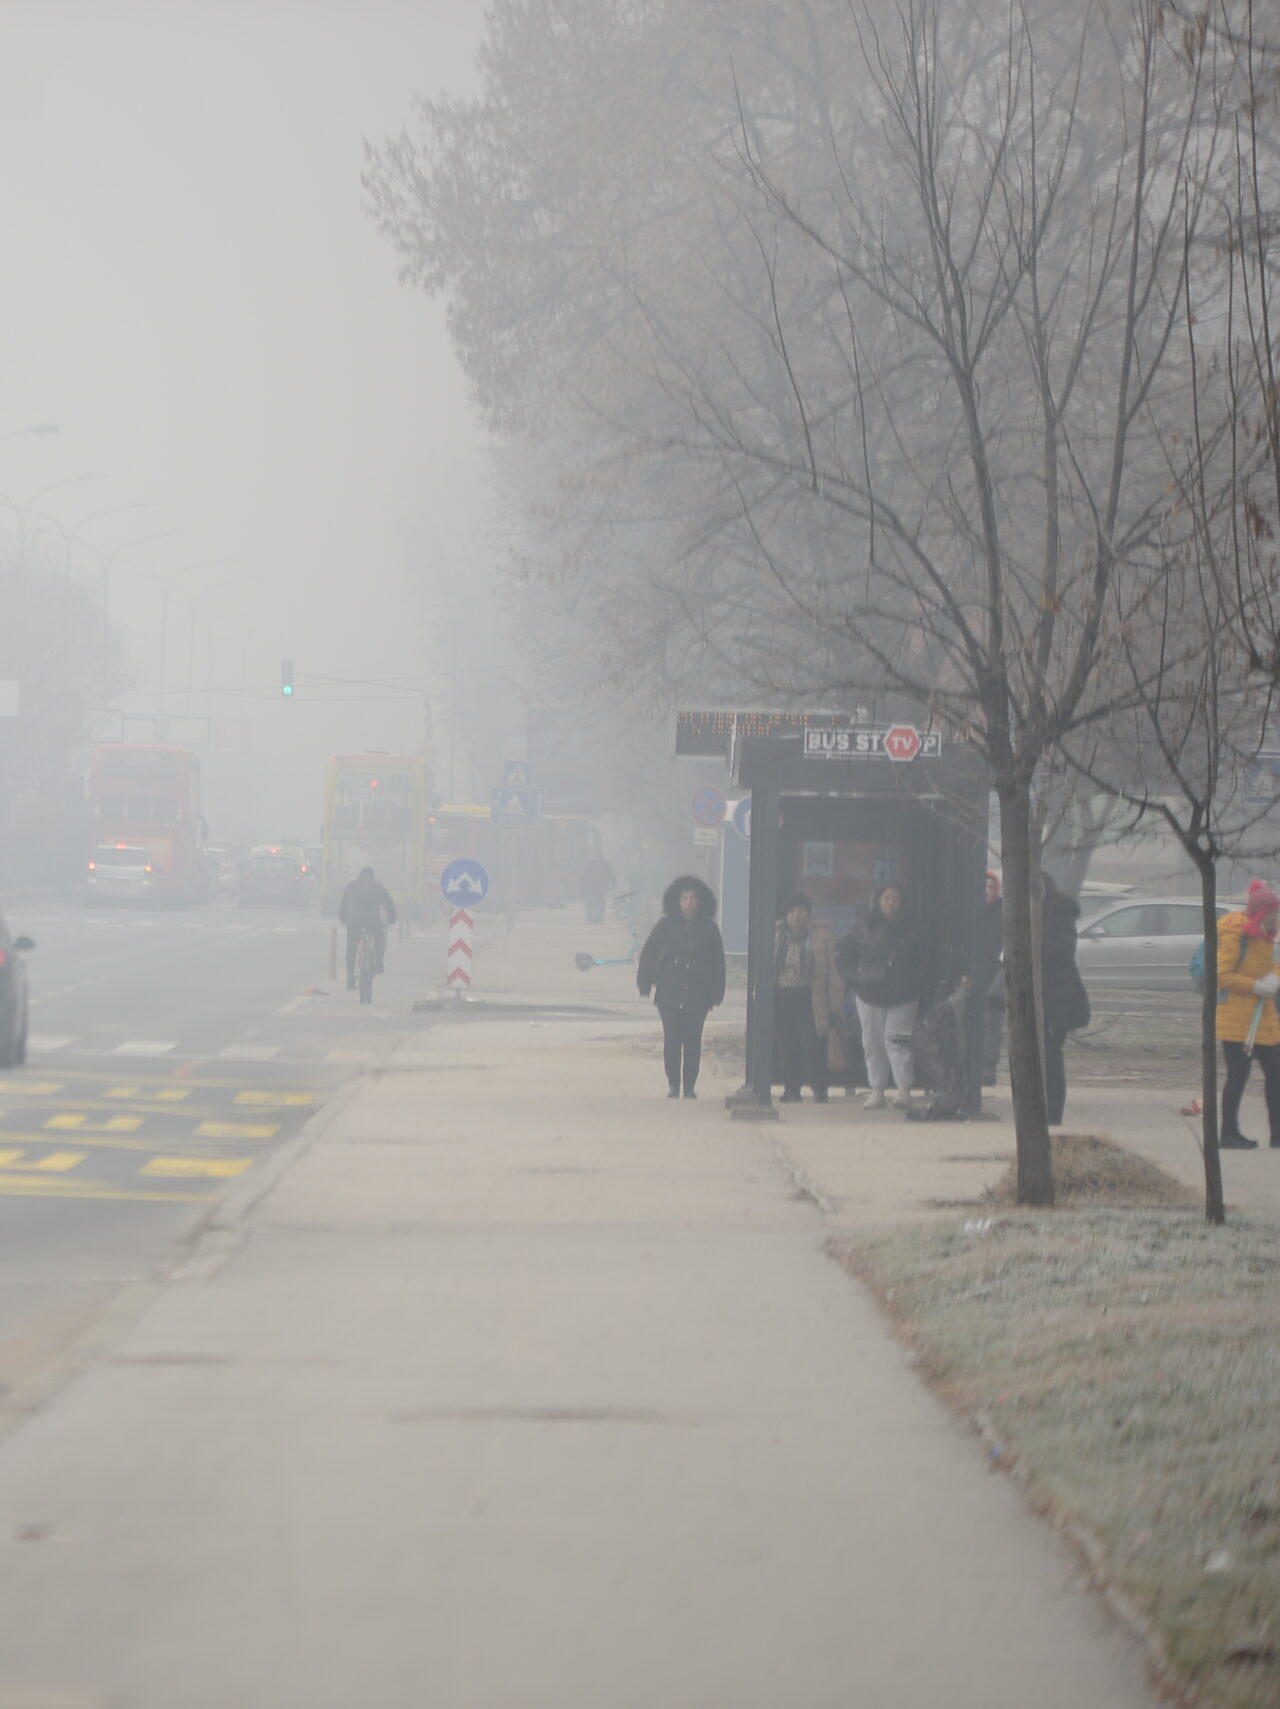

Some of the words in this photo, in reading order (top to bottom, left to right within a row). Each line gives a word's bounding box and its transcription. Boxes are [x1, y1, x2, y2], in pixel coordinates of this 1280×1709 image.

[808, 734, 849, 750] BUS
[856, 735, 937, 752] STP
[891, 736, 914, 750] TV
